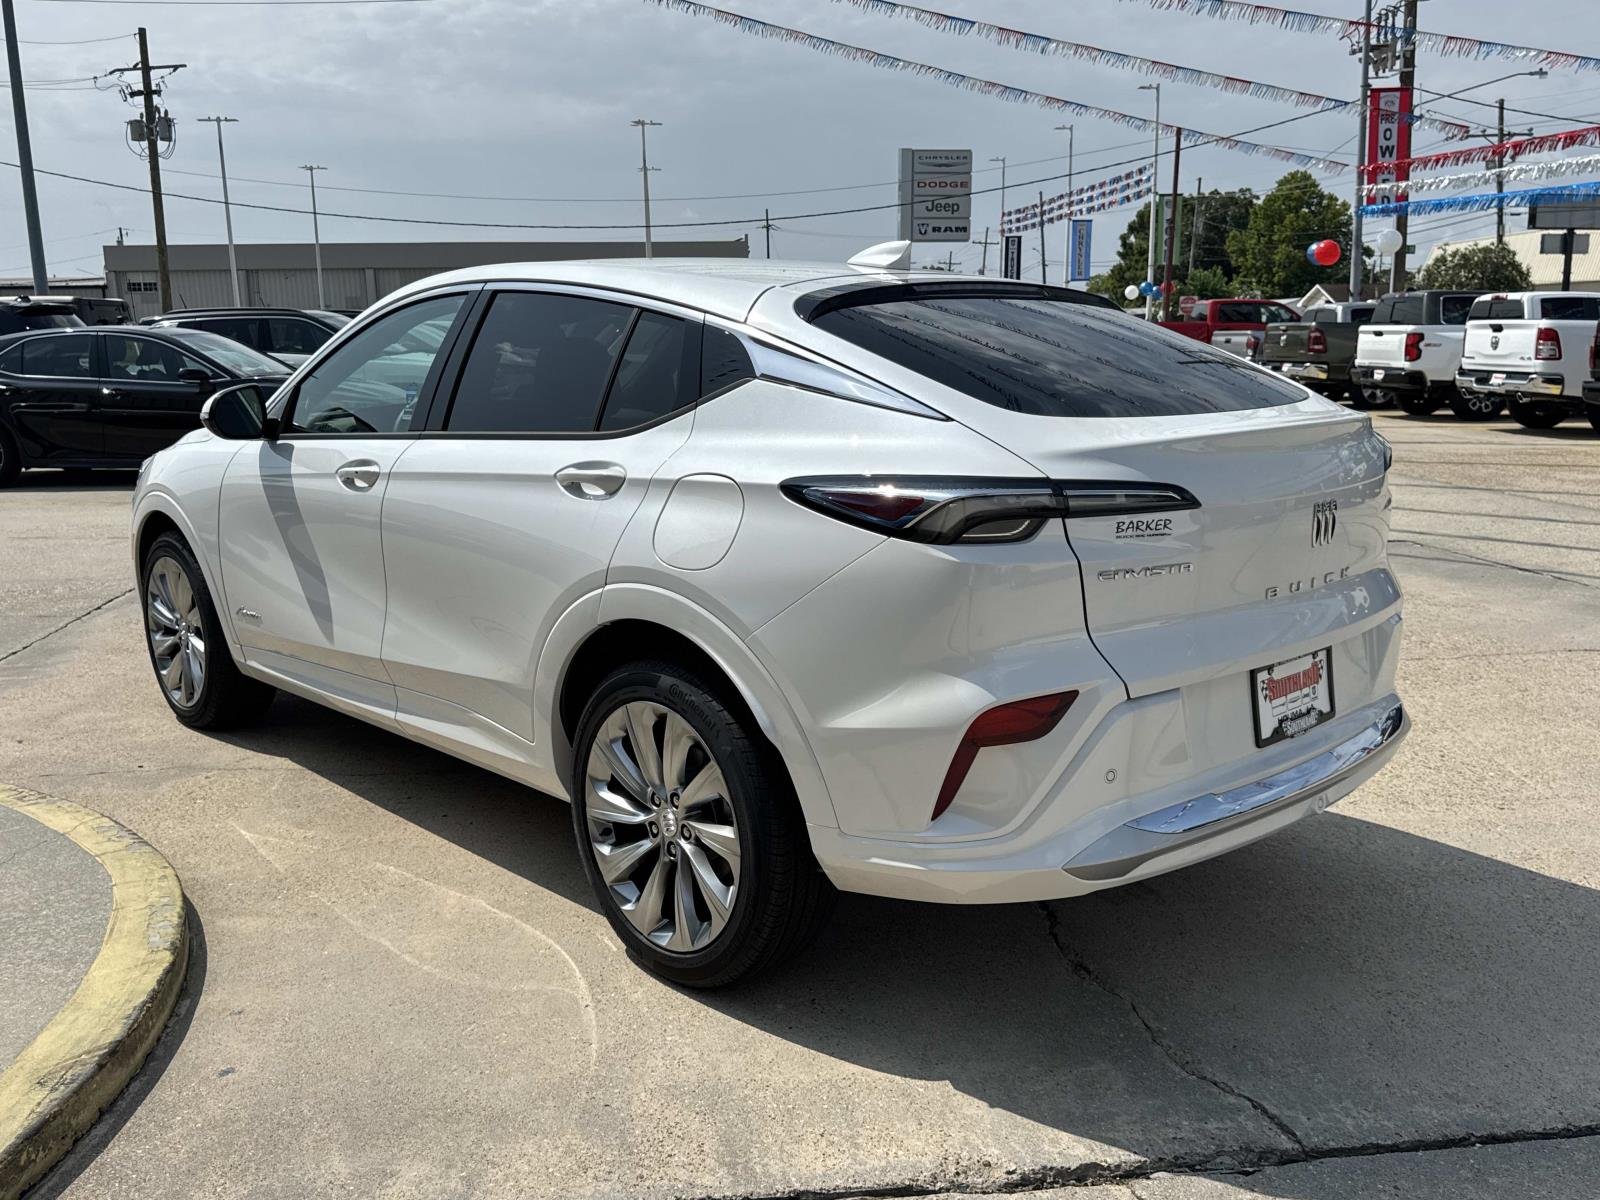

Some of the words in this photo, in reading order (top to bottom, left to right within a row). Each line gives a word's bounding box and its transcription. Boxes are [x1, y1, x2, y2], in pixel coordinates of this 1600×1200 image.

[917, 181, 969, 189] DODGE
[925, 199, 960, 214] Jeep
[1115, 518, 1173, 534] BARKER
[1098, 562, 1192, 581] ENVISTA
[1265, 566, 1350, 600] BUICK
[669, 683, 716, 729] Continental
